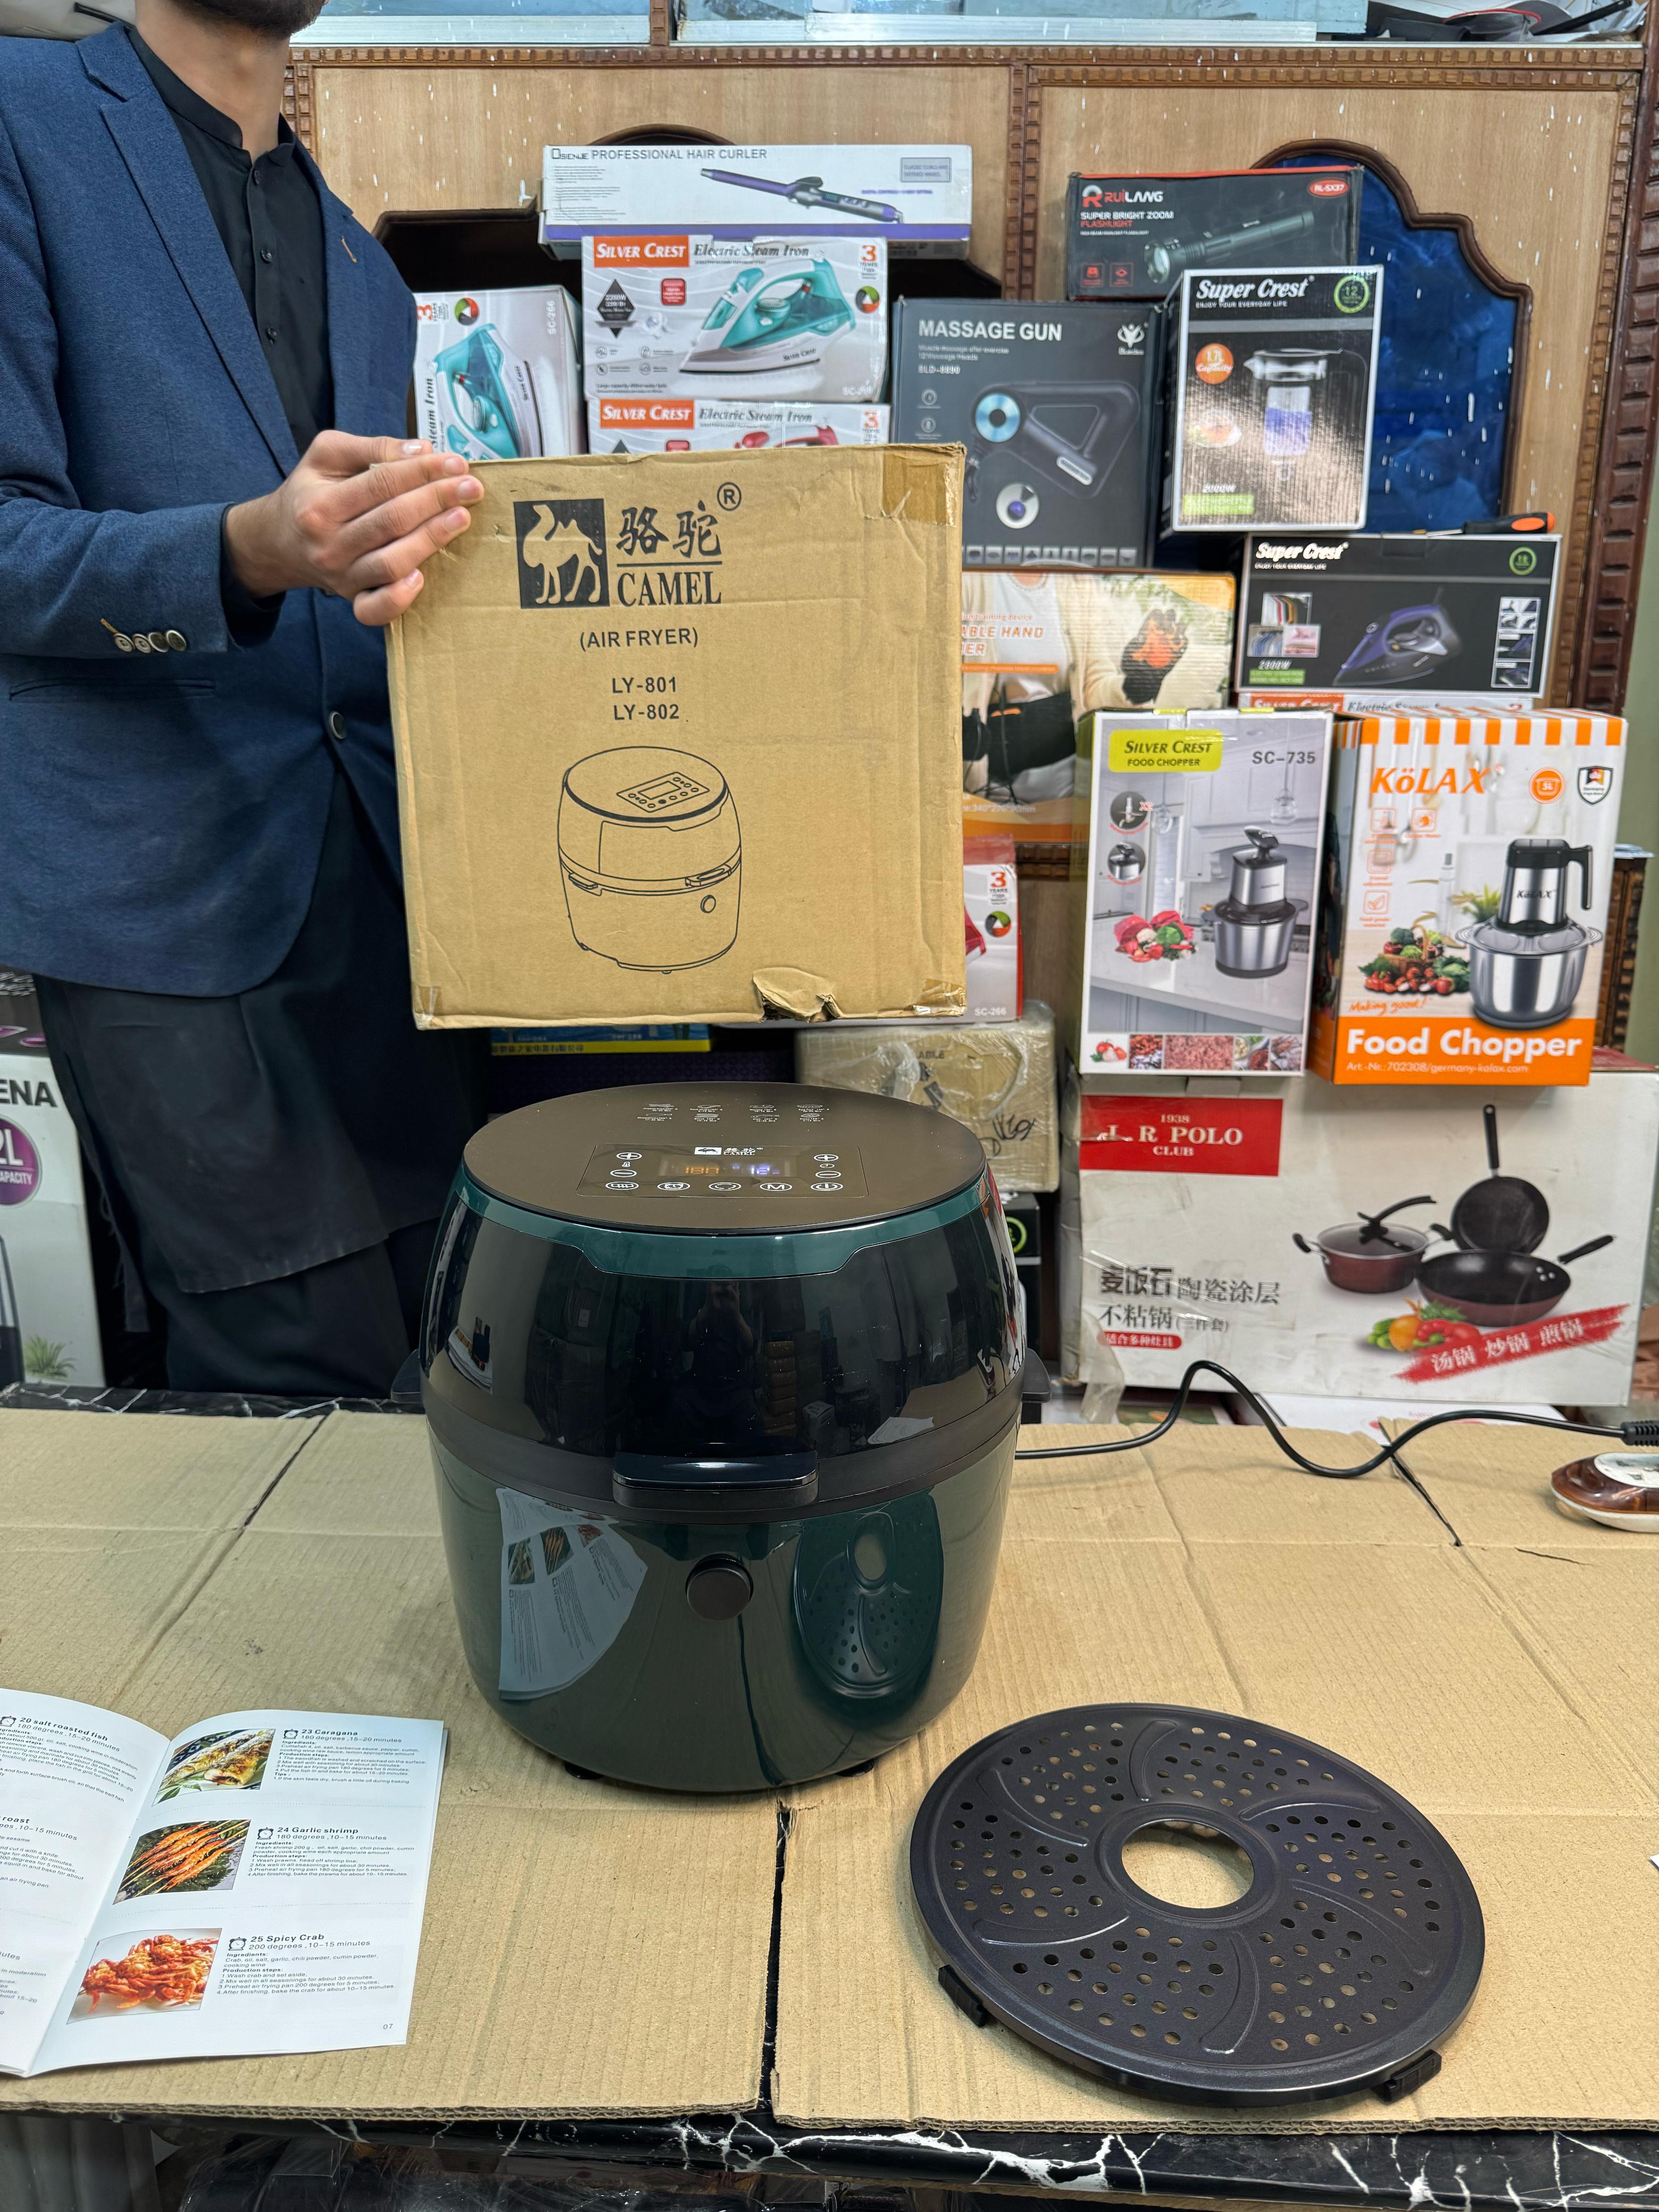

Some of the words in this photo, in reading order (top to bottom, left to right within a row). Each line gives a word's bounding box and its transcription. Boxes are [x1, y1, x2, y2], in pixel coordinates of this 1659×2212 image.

[591, 149, 681, 159] PROFESSIONAL
[688, 149, 715, 159] HAIR
[719, 149, 767, 160] CURLER
[1146, 211, 1174, 220] ZOOM
[596, 243, 640, 258] SILVER
[644, 242, 686, 258] CREST
[694, 244, 741, 257] Electric
[783, 246, 809, 256] Iron
[861, 245, 876, 262] 3
[1196, 280, 1255, 303] Super
[1257, 276, 1309, 298] Crest
[546, 300, 557, 334] SC-266
[919, 320, 1016, 339] MASSAGE
[1019, 323, 1062, 341] GUN
[424, 378, 435, 405] Iron
[602, 406, 646, 421] SILVER
[650, 405, 691, 420] CREST
[700, 409, 744, 422] Electric
[747, 409, 783, 422] Steam
[787, 410, 812, 422] Iron
[862, 412, 878, 428] 3
[616, 500, 722, 558] 骆驼
[1256, 542, 1303, 562] Super
[1303, 543, 1344, 559] Crest
[617, 571, 722, 607] CAMEL
[580, 631, 621, 652] (AIR
[626, 627, 699, 648] FRYER)
[1001, 626, 1045, 638] HAND
[611, 676, 677, 694] LY-801
[613, 704, 680, 722] LY-802
[1124, 741, 1168, 754] SILVER
[1172, 741, 1213, 753] CREST
[1252, 751, 1316, 765] SC-735
[990, 871, 1007, 887] 3
[974, 1008, 1007, 1016] SC-266
[1350, 1000, 1387, 1015] Making
[1390, 995, 1428, 1011] good!
[1346, 1027, 1430, 1055] Food
[1439, 1027, 1583, 1063] Chopper
[1161, 1114, 1190, 1124] 1938
[1138, 1125, 1158, 1143] R
[1170, 1126, 1243, 1145] POLO
[1153, 1145, 1195, 1157] CLUB
[1100, 1303, 1172, 1329] 不粘锅
[1431, 1344, 1477, 1373] 汤锅
[1485, 1331, 1530, 1358] 炒锅
[1539, 1318, 1585, 1347] 煎锅
[32, 1726, 64, 1736] degrees
[91, 1739, 120, 1752] minutes
[53, 1724, 90, 1736] roasted
[91, 1732, 108, 1741] fish
[46, 1829, 78, 1841] minutes
